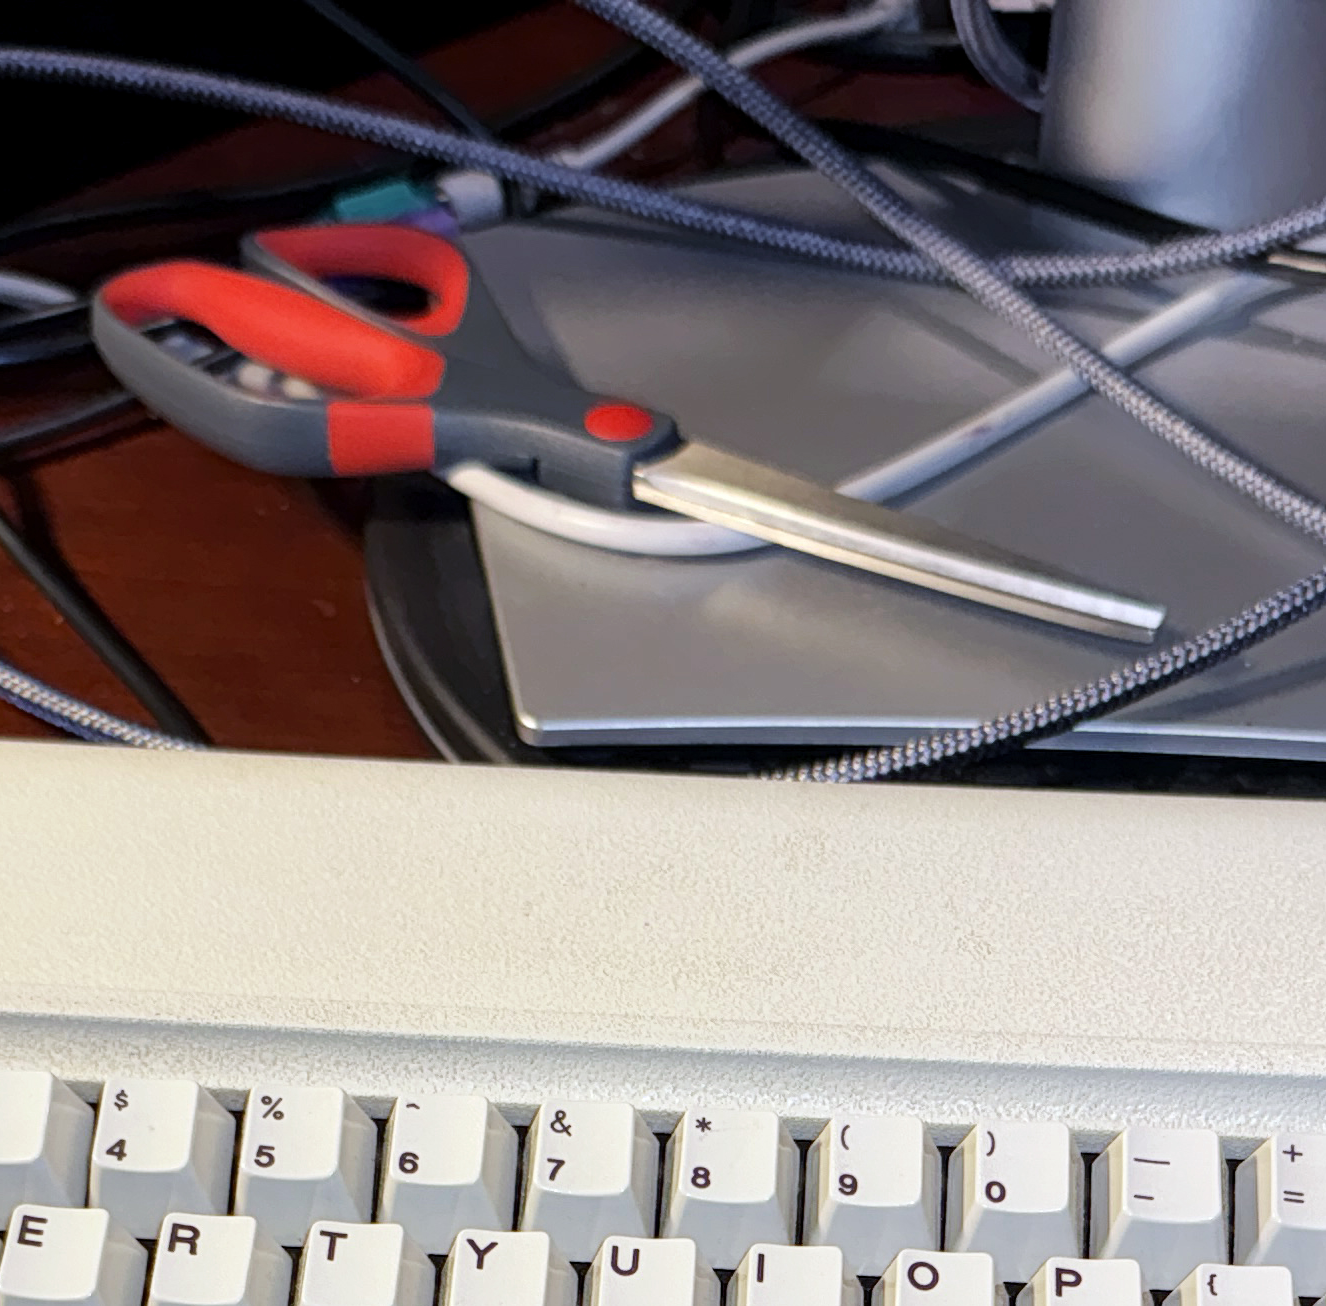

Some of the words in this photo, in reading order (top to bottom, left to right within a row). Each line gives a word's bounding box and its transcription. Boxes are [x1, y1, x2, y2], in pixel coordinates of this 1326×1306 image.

[105, 1139, 127, 1161] 4
[254, 1145, 275, 1168] 5
[398, 1152, 419, 1174] 6
[547, 1158, 565, 1181] 7
[691, 1166, 711, 1189] 8
[838, 1174, 858, 1196] 9
[985, 1181, 1006, 1203] 0
[17, 1215, 48, 1247] E
[167, 1223, 200, 1255] R
[320, 1230, 348, 1261] T
[466, 1238, 498, 1270] Y
[610, 1245, 640, 1276] U
[1055, 1267, 1082, 1297] P
